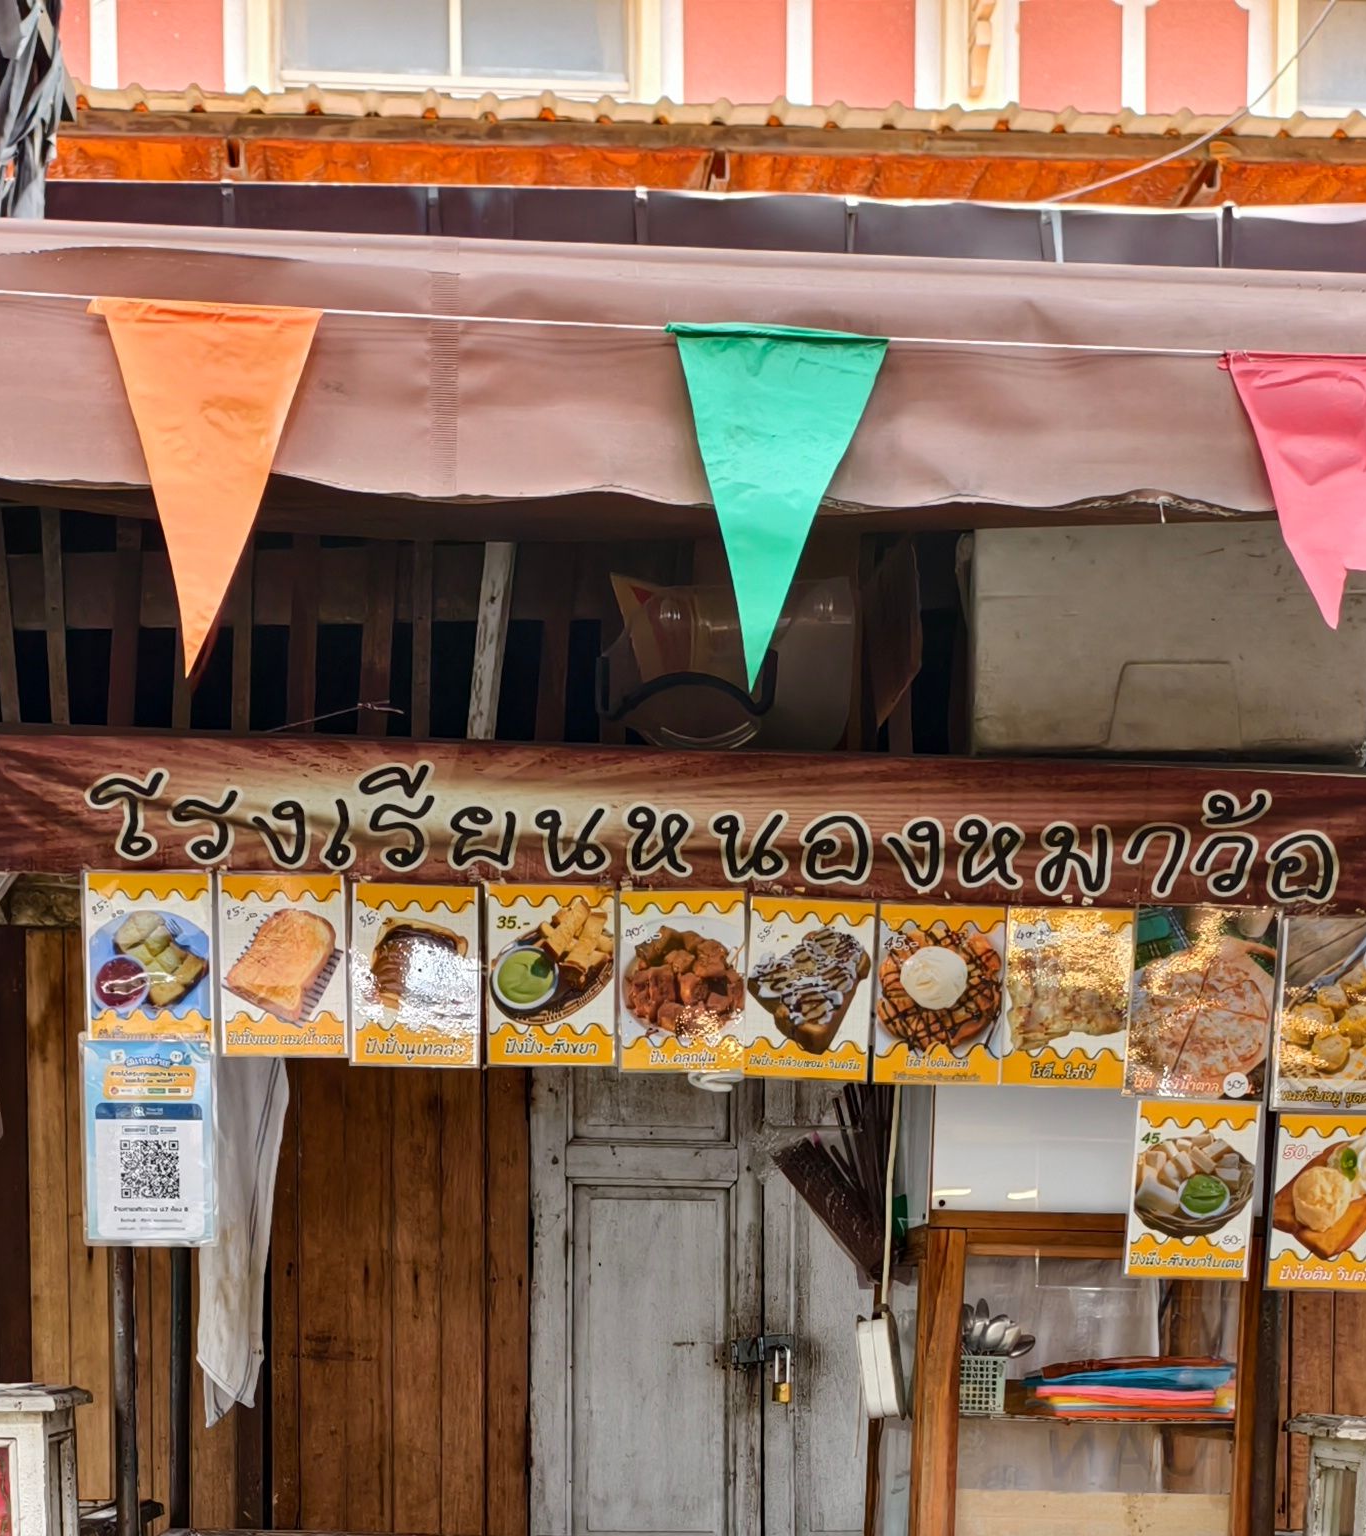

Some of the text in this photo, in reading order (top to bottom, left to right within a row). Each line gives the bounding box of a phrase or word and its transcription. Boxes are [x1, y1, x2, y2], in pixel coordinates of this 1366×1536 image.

[88, 762, 1341, 902] โรงเรียนหนองหมาว้อ
[496, 916, 530, 930] 35.-
[505, 1033, 597, 1055] ปังปิ้ง-สังขยา
[1279, 1264, 1332, 1281] ปังไอติม
